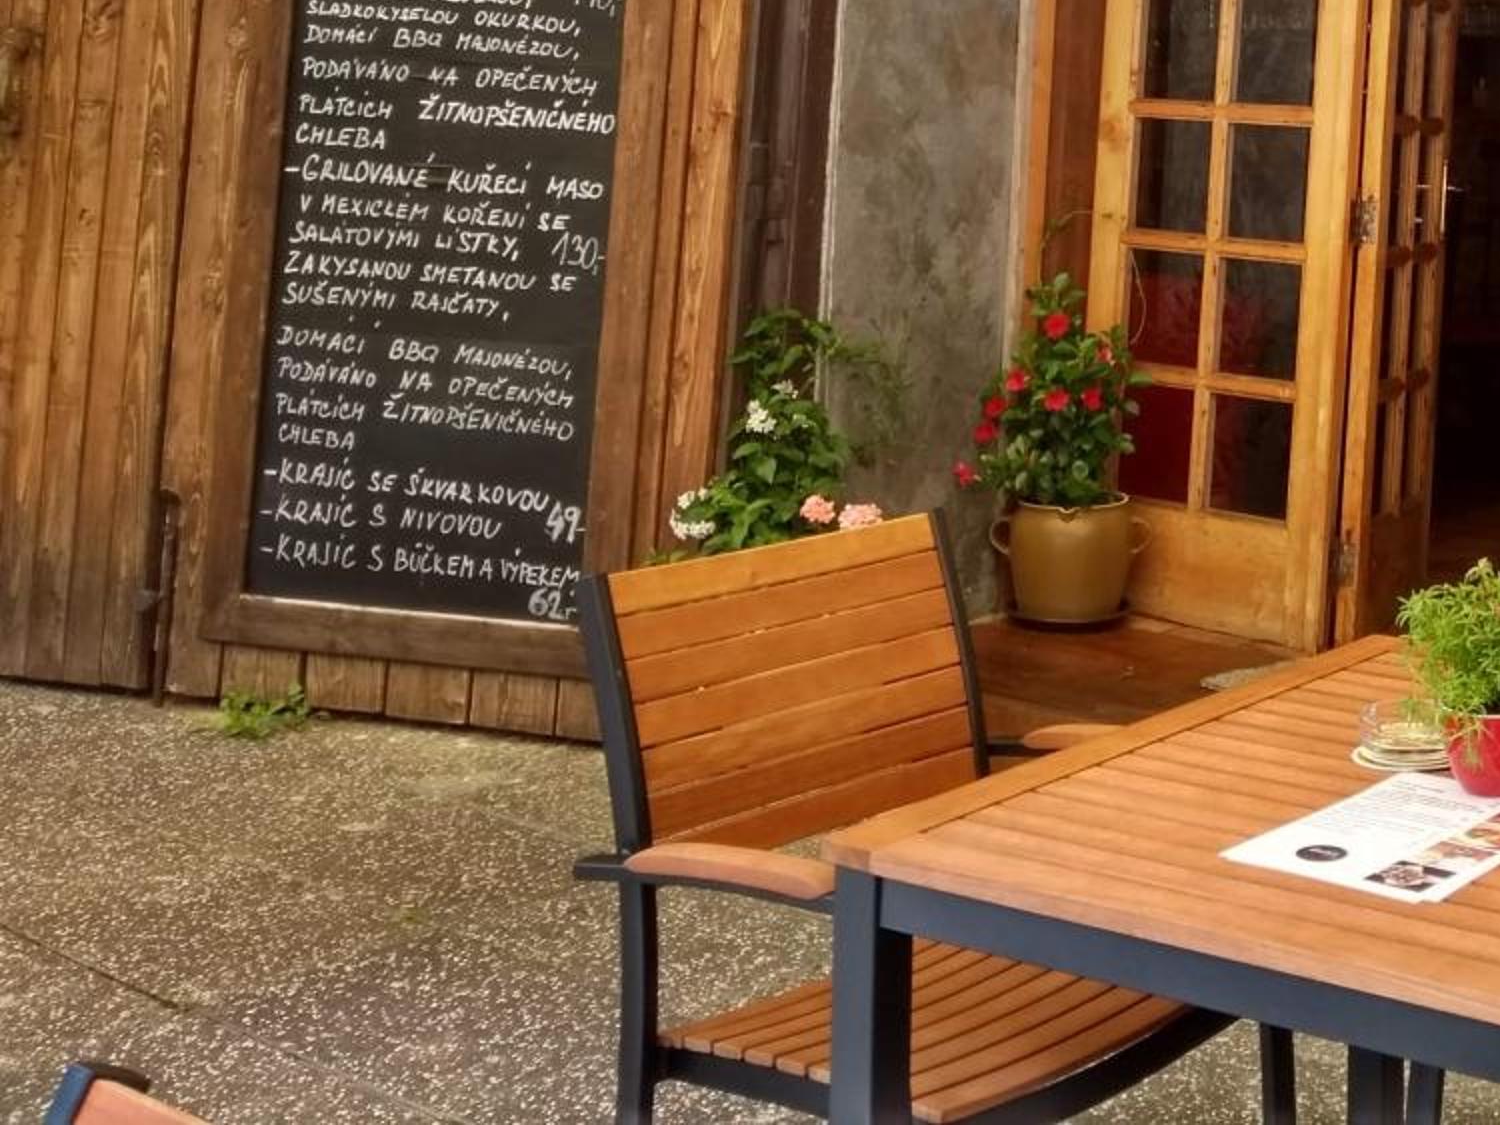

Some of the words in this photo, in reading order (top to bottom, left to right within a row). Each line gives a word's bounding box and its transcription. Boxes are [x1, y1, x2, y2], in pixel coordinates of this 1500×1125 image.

[303, 24, 377, 44] DOMÁCÍ
[394, 28, 442, 48] BBQ
[429, 65, 458, 86] NA
[476, 65, 597, 96] OPEČENÝCH
[295, 122, 386, 149] CHLEBA
[447, 162, 531, 194] KUŘECÍ
[546, 180, 604, 199] MASO
[301, 194, 312, 212] V
[443, 203, 531, 229] KOŘENÍ
[538, 212, 571, 230] SE
[284, 251, 411, 281] ZAKYSANOU
[420, 263, 537, 291] SMETANOU
[550, 274, 577, 292] SE
[282, 280, 396, 309] SUŠENÝMI
[388, 339, 439, 363] BBQ
[277, 356, 376, 387] PODÁVÁNO
[400, 370, 433, 393] NA
[448, 377, 574, 407] OPEČENÝCH
[278, 424, 355, 451] CHLEBA
[367, 472, 396, 493] SE
[369, 505, 387, 527] S
[400, 508, 502, 539] NIVOVOU
[367, 547, 383, 572] S
[395, 543, 474, 578] BŮČKEM
[480, 560, 492, 580] A
